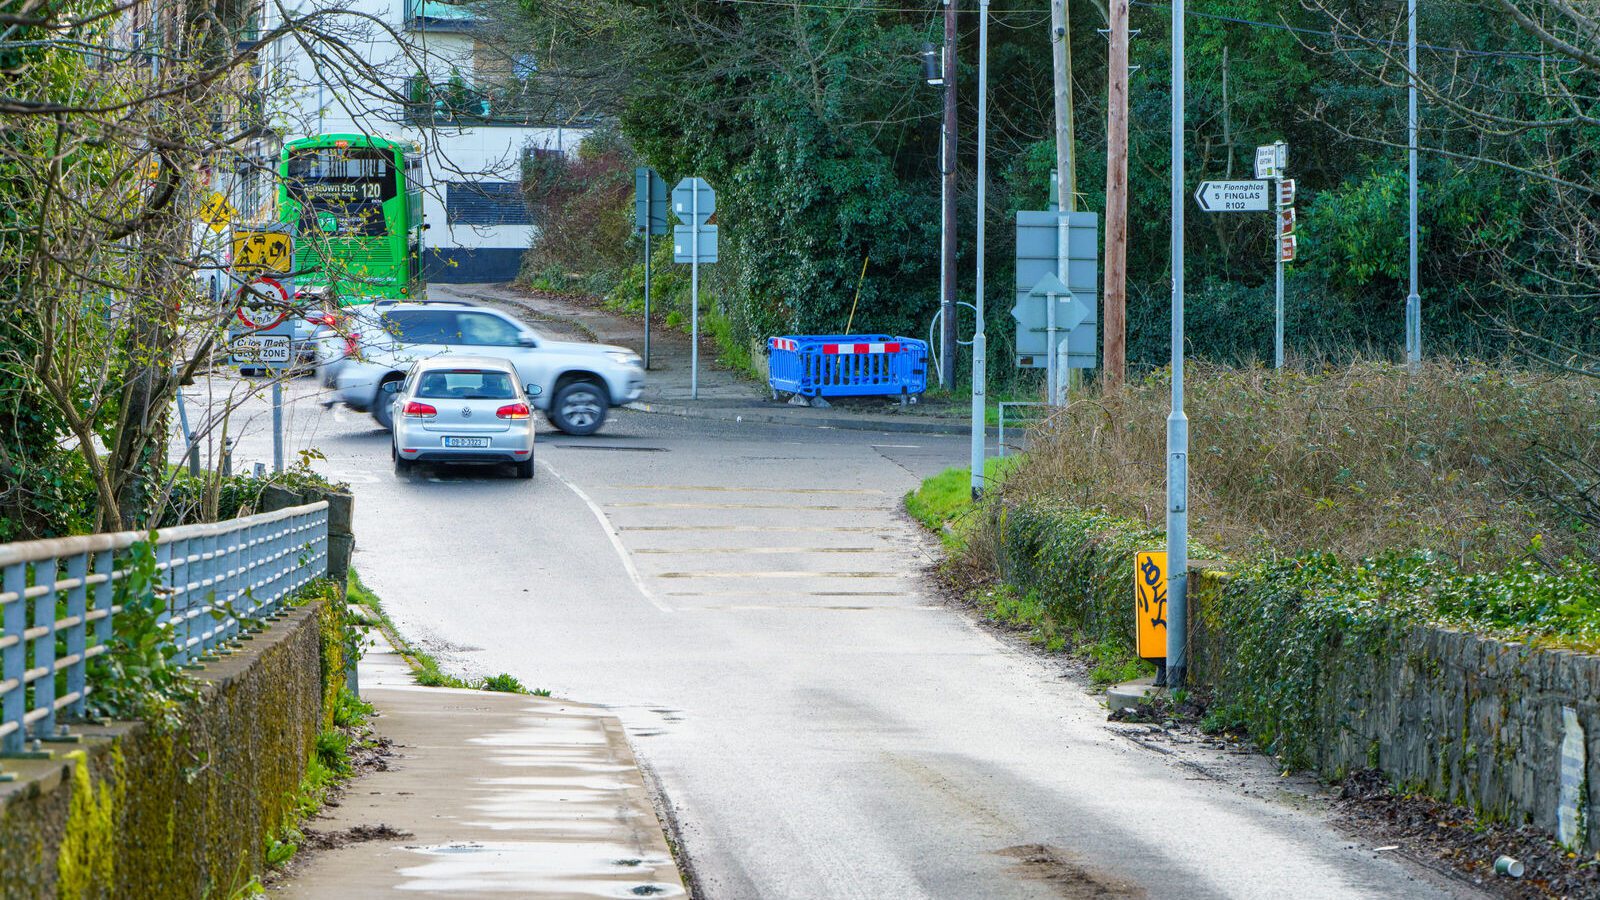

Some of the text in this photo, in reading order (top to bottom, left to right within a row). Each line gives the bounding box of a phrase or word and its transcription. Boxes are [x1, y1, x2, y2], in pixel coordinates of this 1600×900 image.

[342, 183, 359, 192] Stn.
[361, 183, 381, 198] 120
[1224, 183, 1264, 191] Fionnghlas
[263, 349, 286, 357] ZONE
